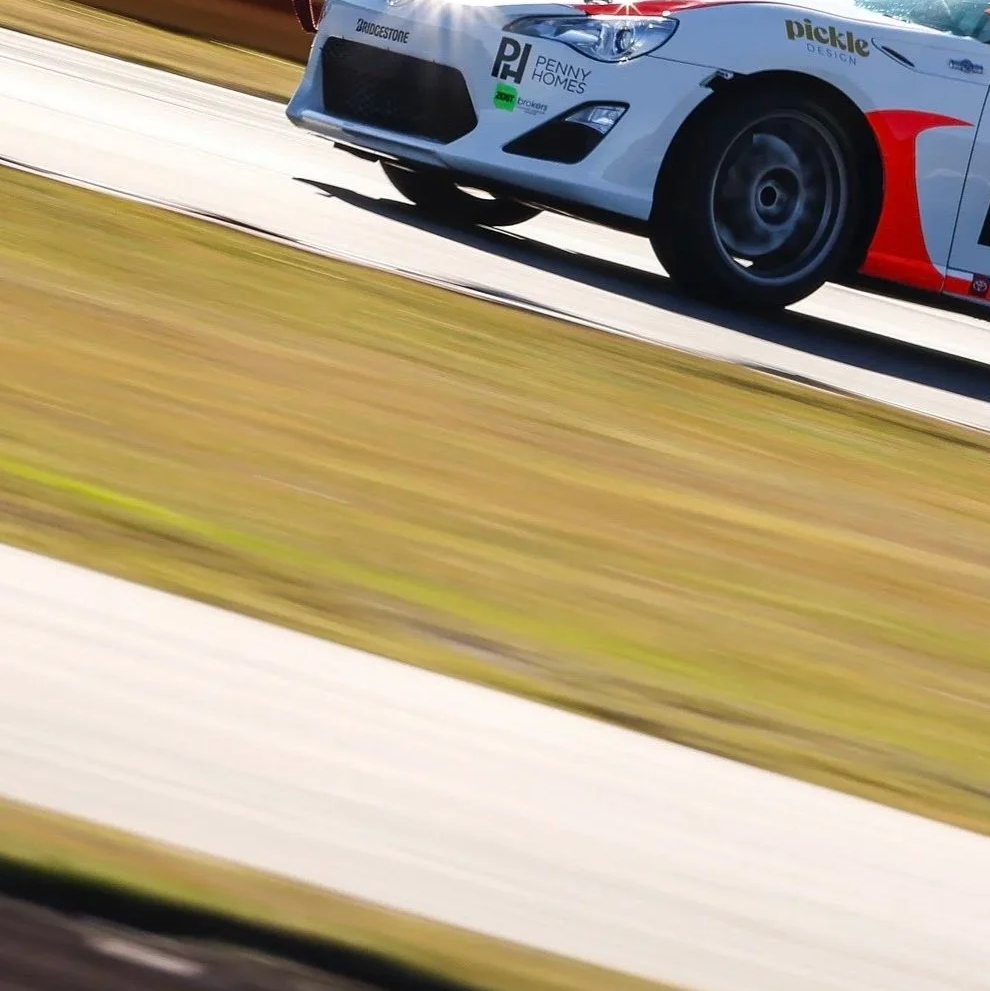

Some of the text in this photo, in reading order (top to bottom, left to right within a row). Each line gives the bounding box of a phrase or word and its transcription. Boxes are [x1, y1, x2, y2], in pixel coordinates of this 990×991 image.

[355, 18, 411, 44] BRIDGESTONE
[784, 18, 871, 58] pickle
[806, 43, 857, 66] DESIGN
[531, 68, 588, 94] HOMES
[535, 55, 592, 81] PENNY
